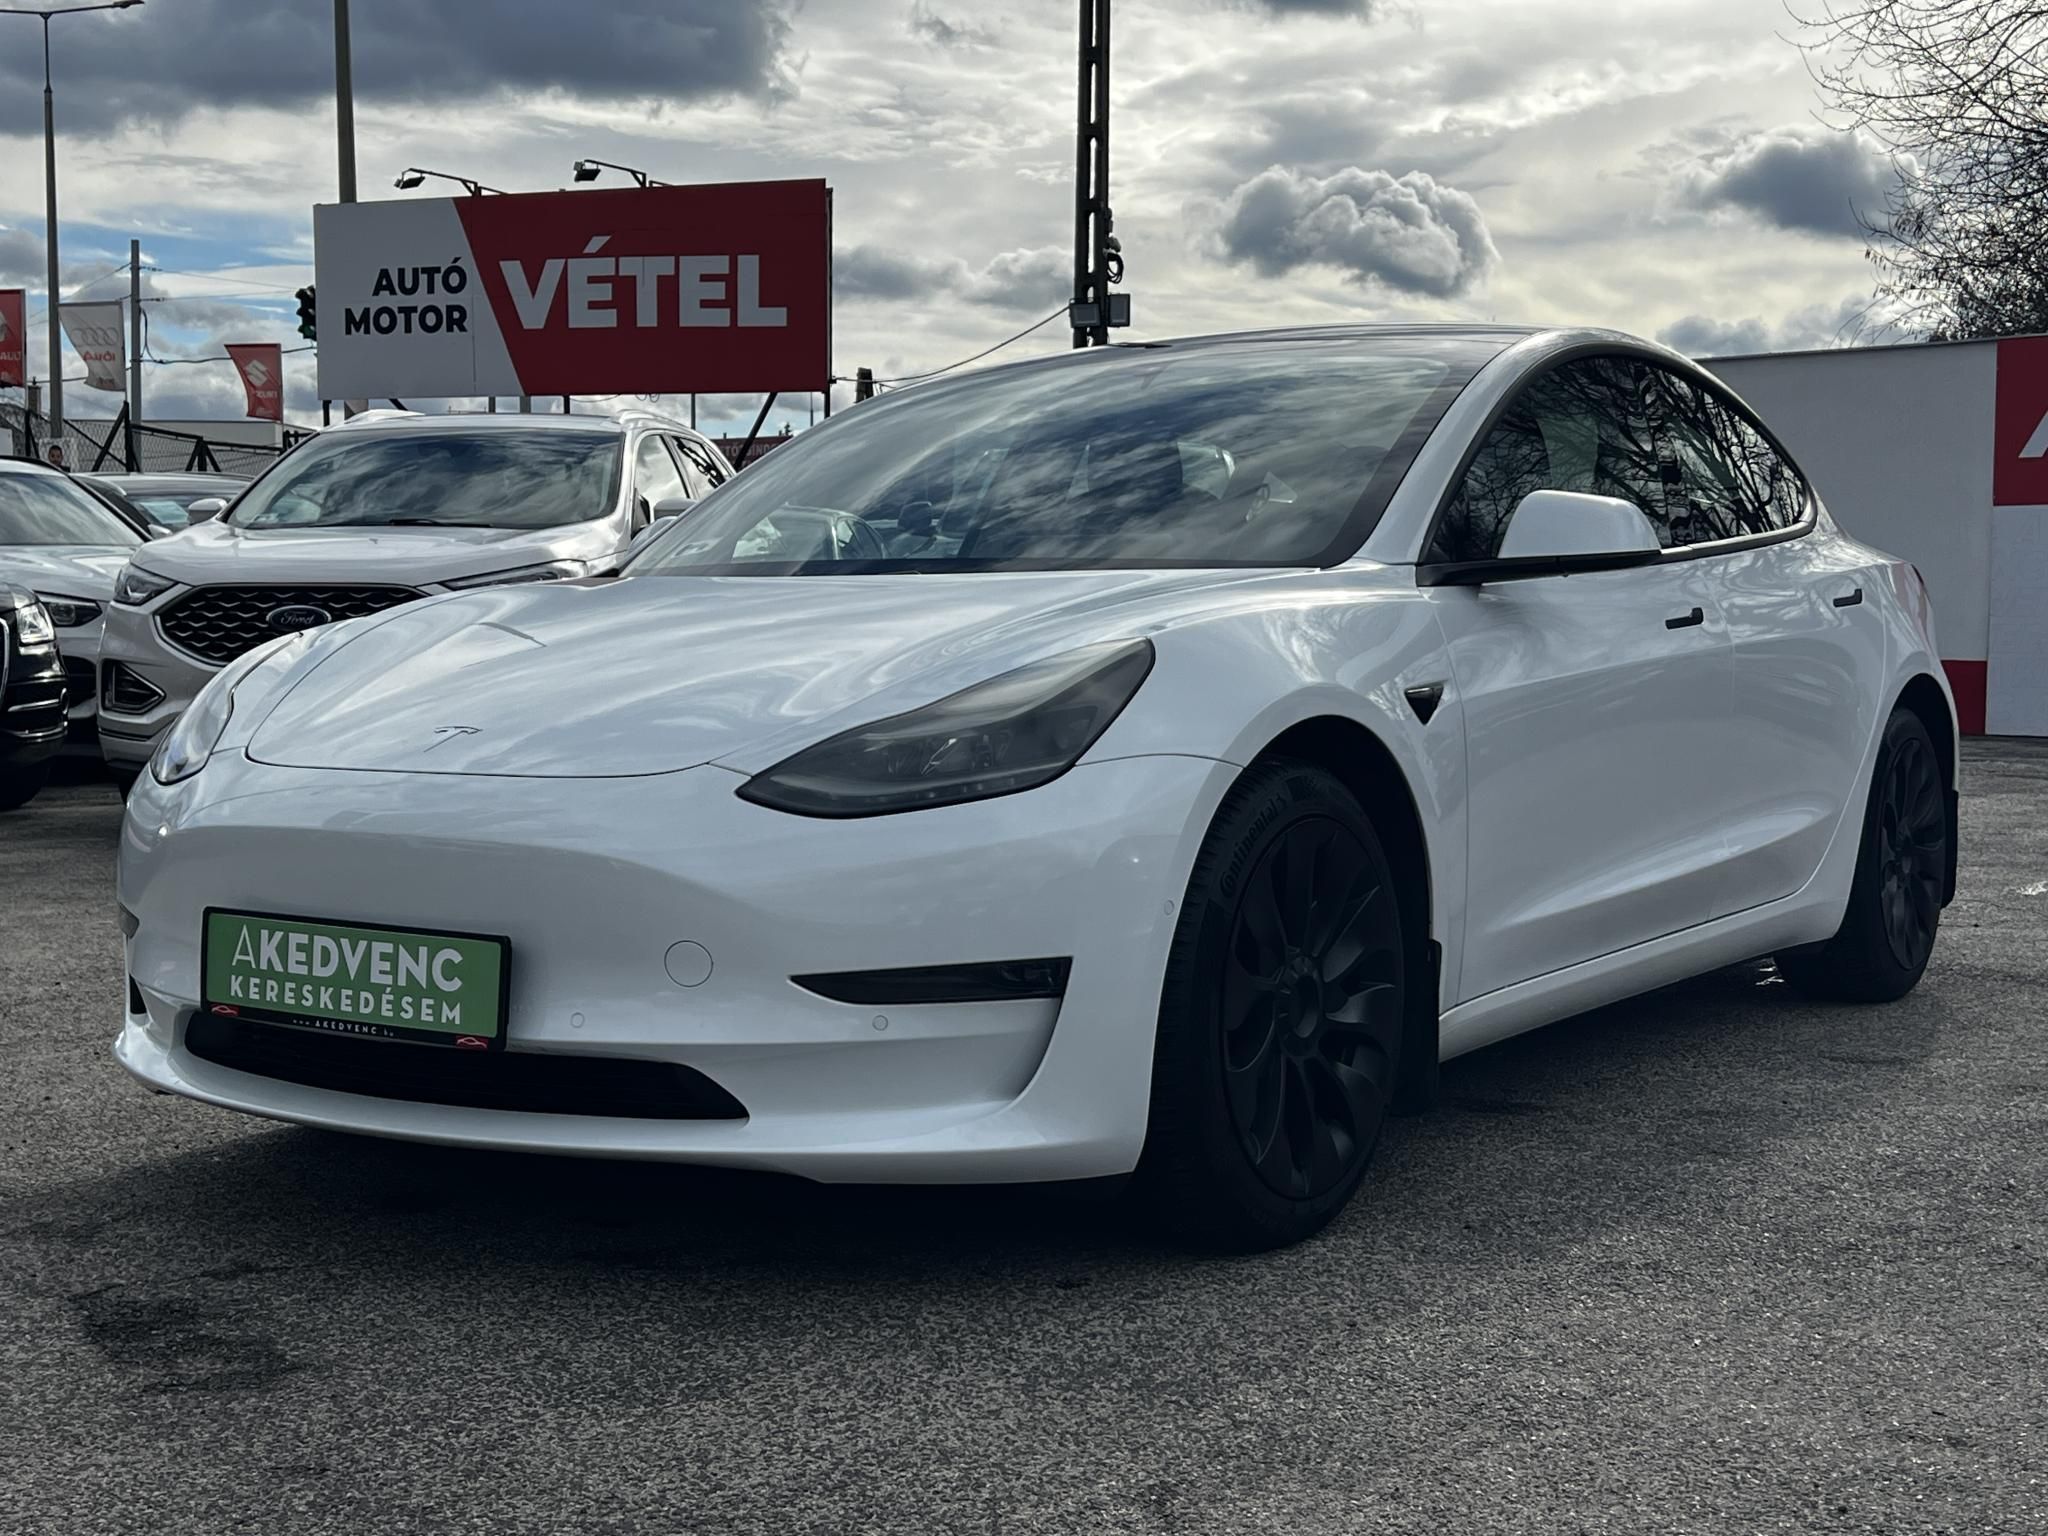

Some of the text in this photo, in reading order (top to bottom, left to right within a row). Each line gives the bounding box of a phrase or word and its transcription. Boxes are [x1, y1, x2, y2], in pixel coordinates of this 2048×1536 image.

[372, 257, 467, 296] AUTÓ
[499, 235, 788, 330] VÉTEL
[345, 304, 467, 335] MOTOR
[280, 610, 316, 625] Ford
[1219, 797, 1281, 898] Continental
[230, 974, 461, 1025] KERESKEDÉSEM
